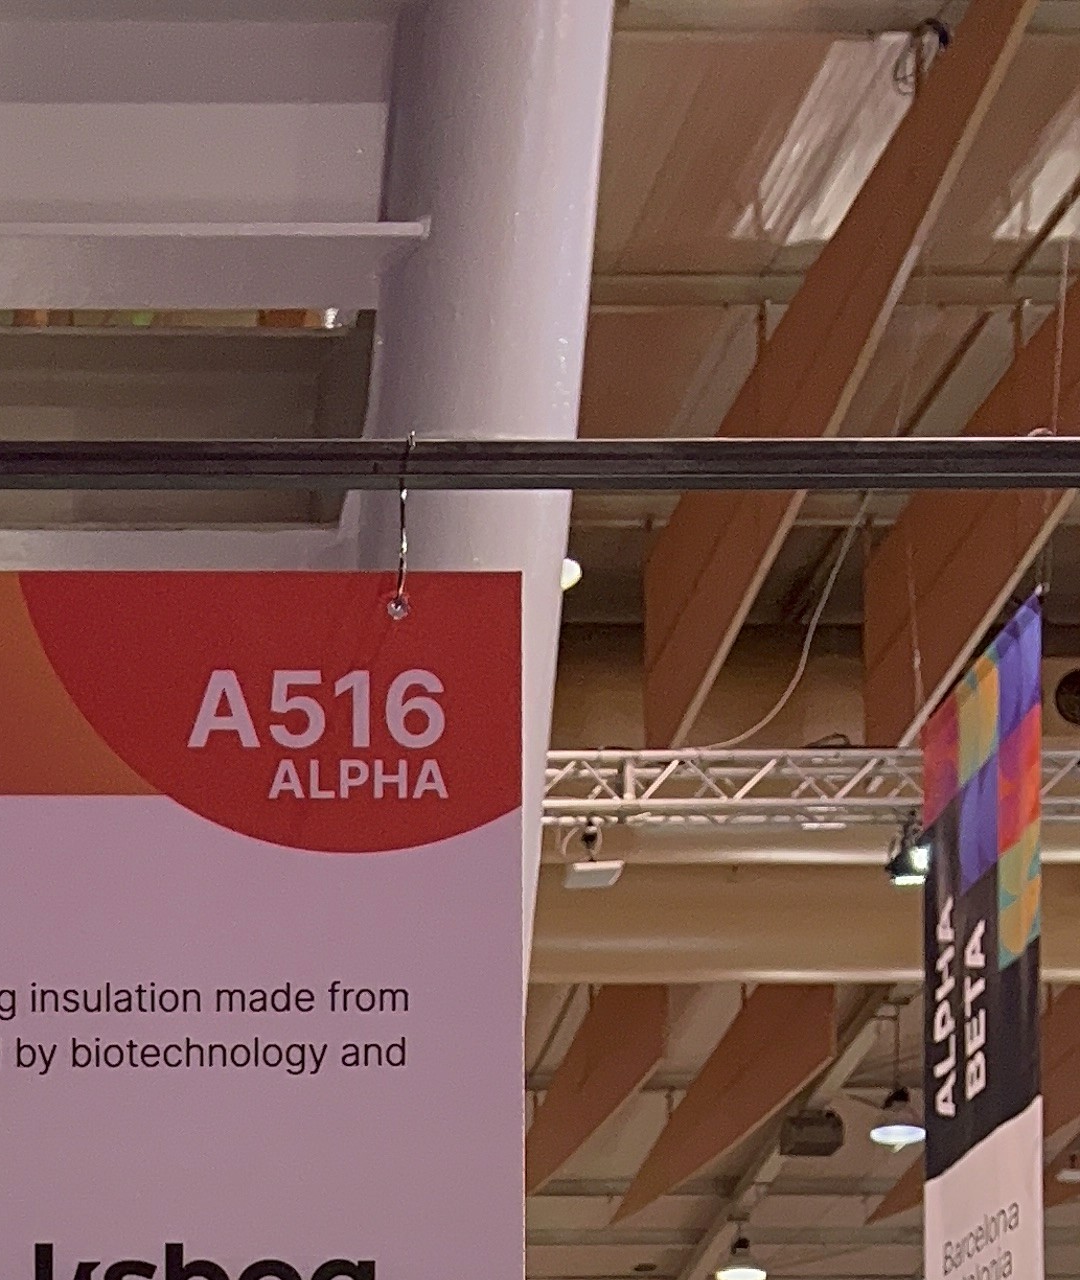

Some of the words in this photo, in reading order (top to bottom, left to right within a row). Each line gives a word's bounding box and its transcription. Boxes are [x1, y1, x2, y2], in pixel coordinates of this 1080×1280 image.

[188, 669, 445, 748] A516
[269, 759, 448, 798] ALPHA
[31, 982, 200, 1012] insulation
[217, 982, 314, 1012] made
[328, 981, 408, 1011] from
[933, 896, 956, 1118] ALPHA
[964, 919, 986, 1100] BETA
[17, 1038, 57, 1075] by
[72, 1037, 327, 1075] biotechnology
[342, 1037, 405, 1066] and
[944, 1202, 1020, 1276] Barcelona
